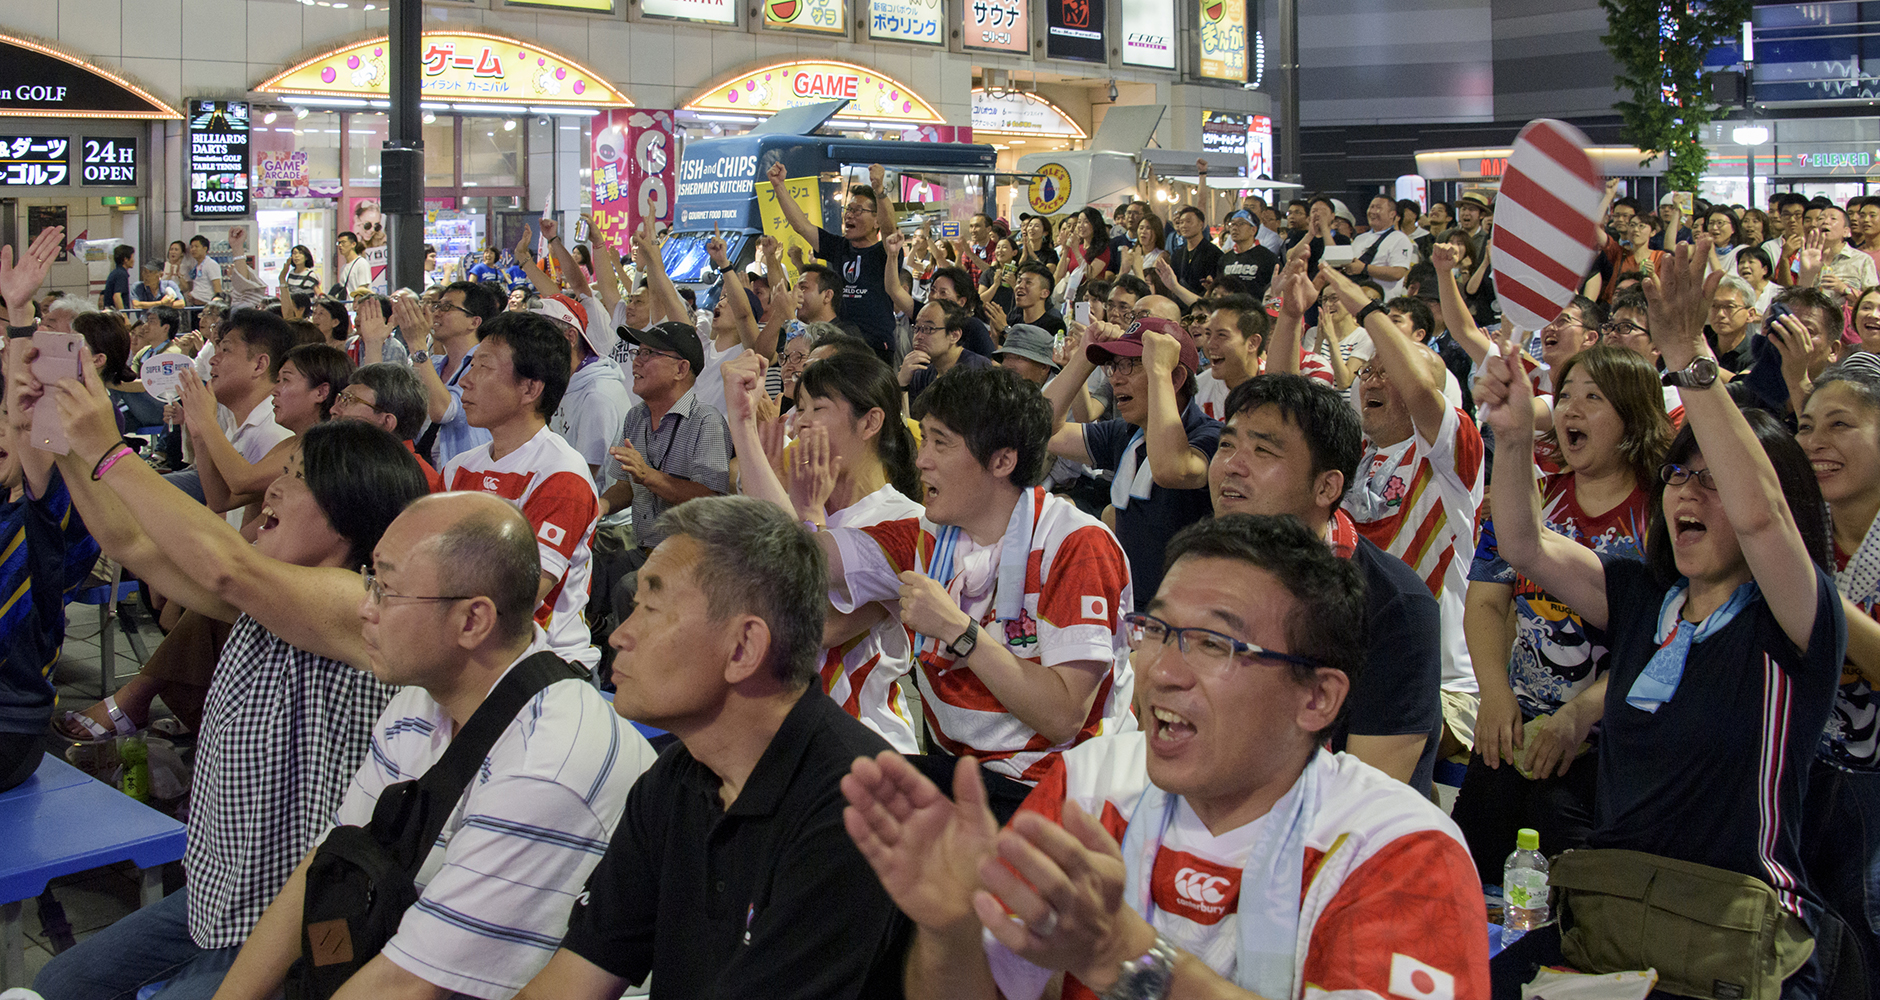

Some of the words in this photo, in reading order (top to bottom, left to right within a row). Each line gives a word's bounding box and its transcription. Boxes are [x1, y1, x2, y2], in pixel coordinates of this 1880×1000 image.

[973, 2, 1019, 27] サウナ
[873, 14, 937, 36] ボウリング
[1128, 33, 1170, 45] FACE
[1202, 22, 1244, 53] まんが
[423, 43, 504, 77] ゲーム
[794, 72, 858, 98] GAME
[16, 85, 67, 101] GOLF
[192, 133, 247, 144] BILLIARDS
[192, 144, 228, 154] DARTS
[84, 166, 134, 180] OPEN
[264, 161, 301, 171] GAME
[703, 163, 717, 175] and
[716, 155, 757, 178] CHIPS
[264, 171, 301, 179] ARCADE
[594, 163, 618, 185] 映画
[596, 181, 628, 204] 半券で
[719, 180, 753, 193] KITCHEN
[197, 191, 244, 203] BAGUS
[766, 187, 810, 202] フシュ
[593, 210, 628, 230] クレーン
[689, 211, 709, 220] GOURMET
[709, 210, 721, 219] FOOD
[722, 210, 737, 218] TRUCK
[1551, 603, 1579, 616] RUG
[1176, 897, 1226, 914] canterbury
